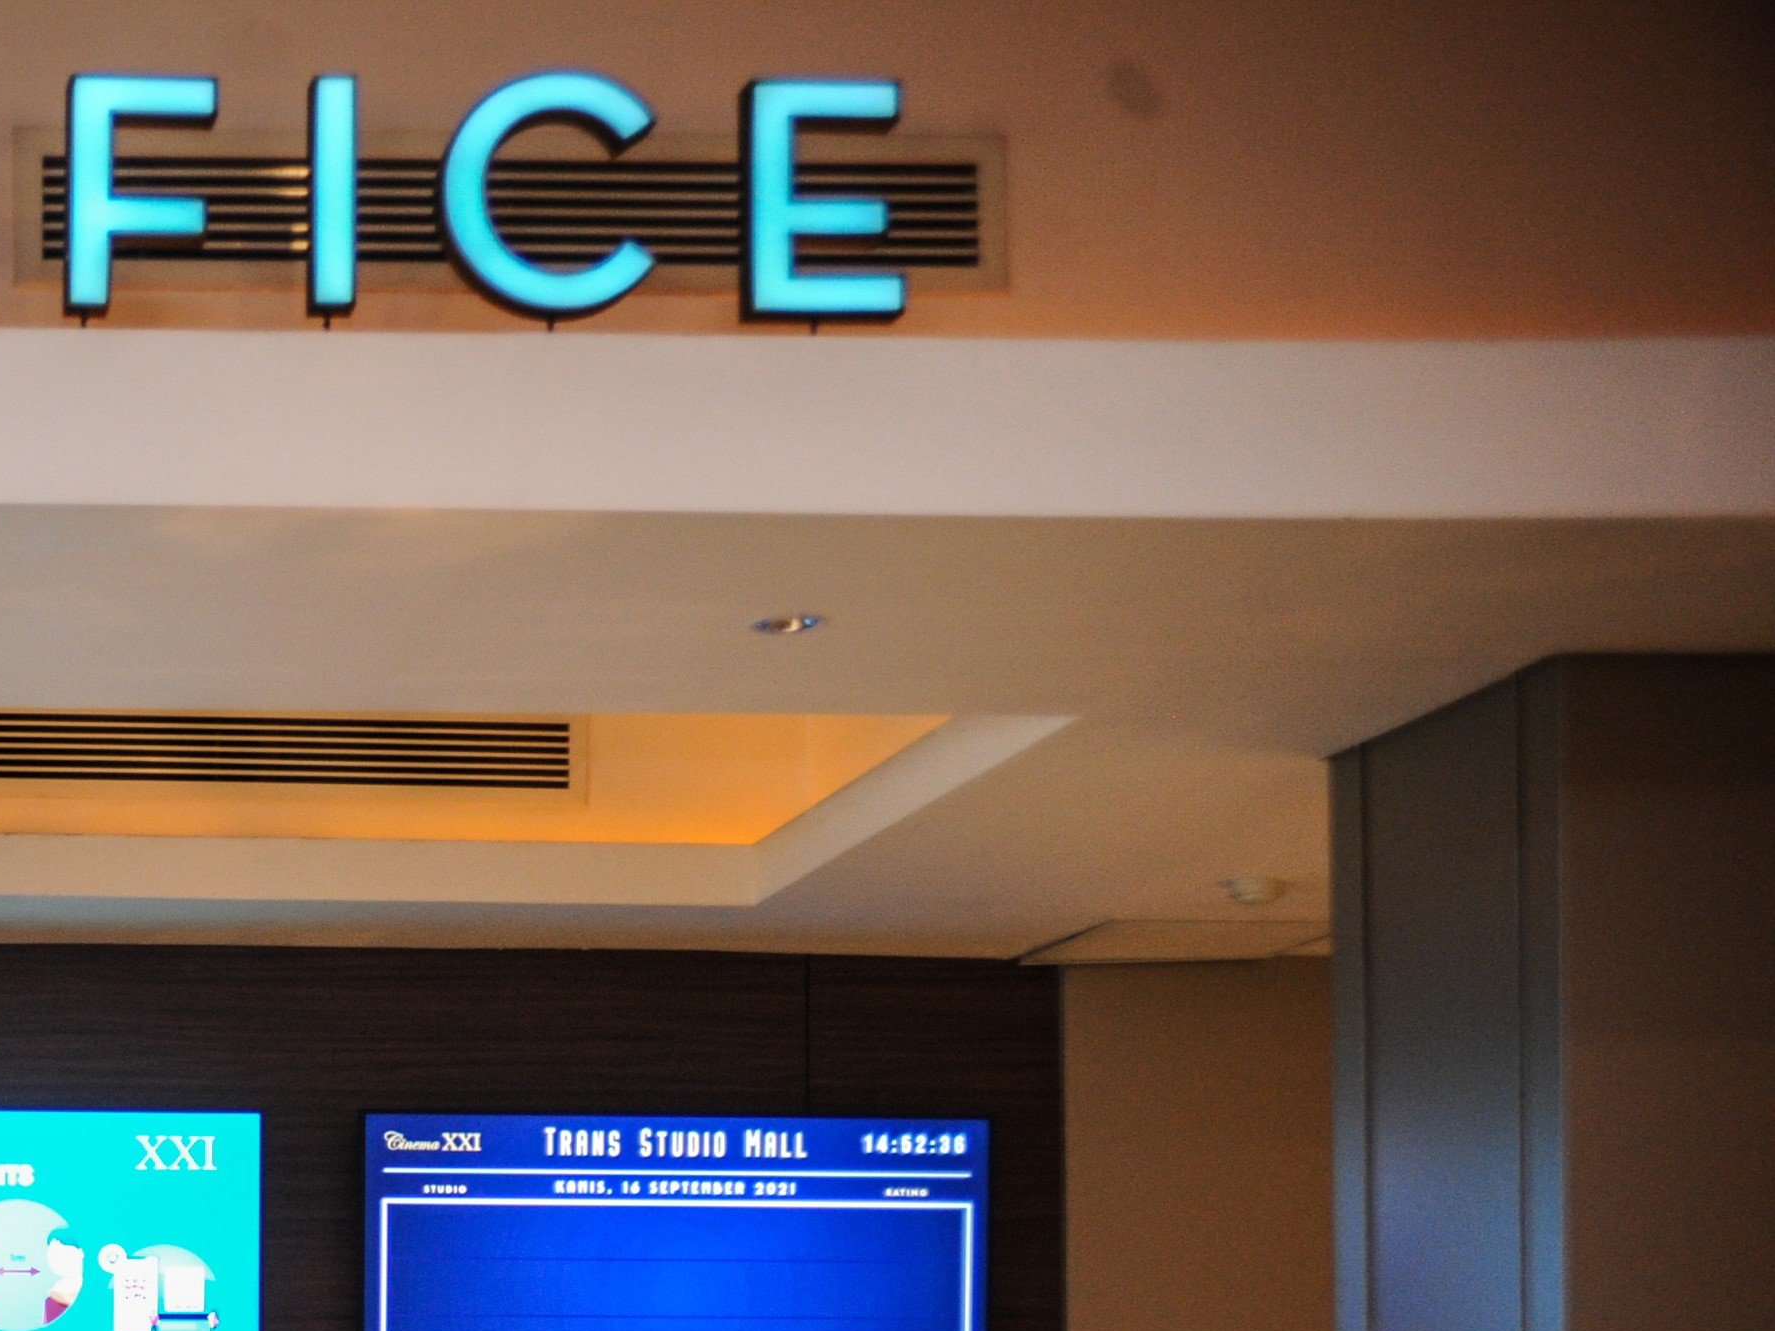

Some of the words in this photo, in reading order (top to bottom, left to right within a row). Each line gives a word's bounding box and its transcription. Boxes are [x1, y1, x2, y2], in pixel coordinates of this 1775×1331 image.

[383, 1130, 442, 1151] Cinema
[441, 1132, 482, 1152] XXI
[543, 1126, 622, 1157] TRANS
[638, 1127, 727, 1158] STUDIO
[743, 1128, 808, 1159] MALL
[135, 1134, 218, 1171] XXI
[423, 1184, 468, 1195] STUDIO
[622, 1180, 641, 1195] 16
[649, 1181, 746, 1196] SEPTEMBER
[754, 1182, 797, 1196] 2021
[884, 1187, 930, 1198] RATING
